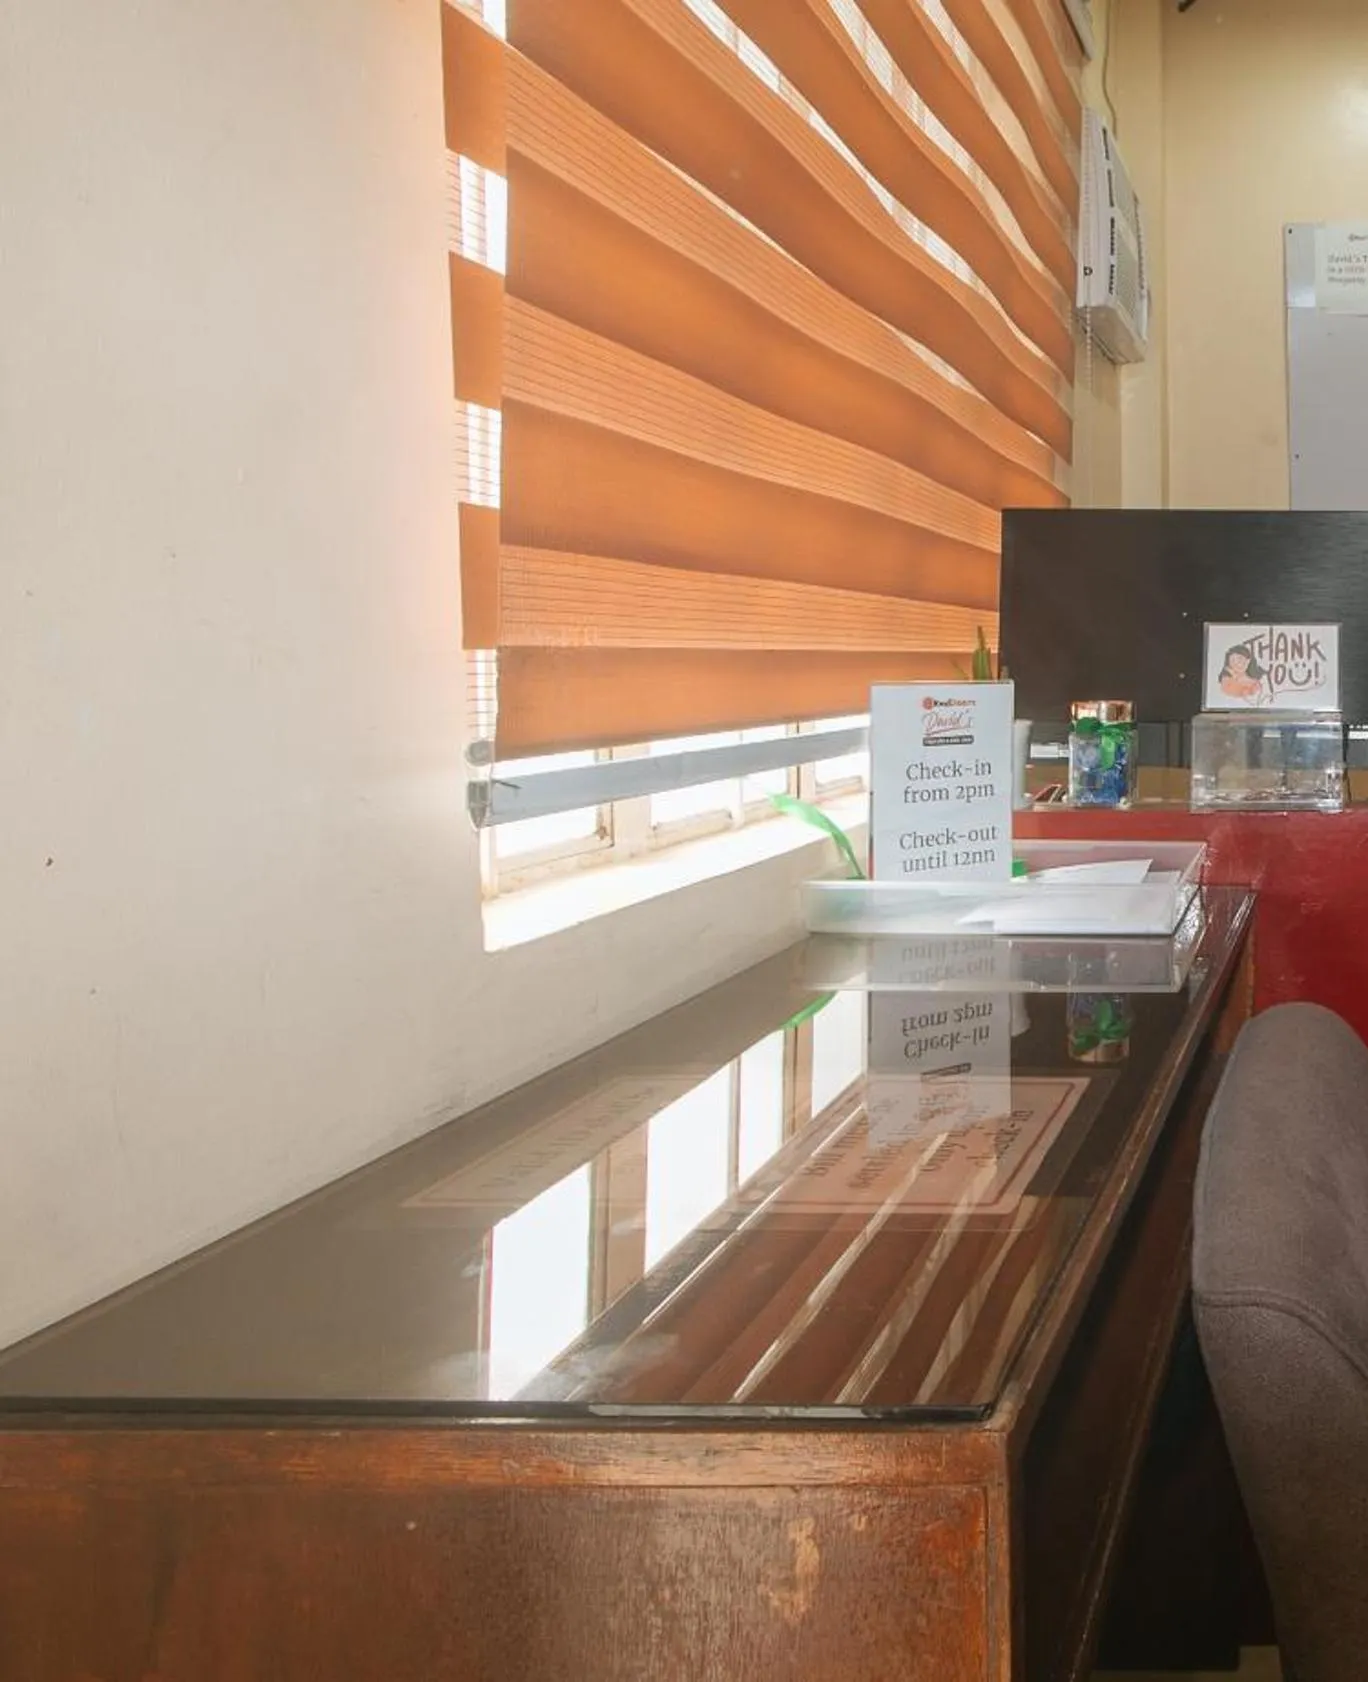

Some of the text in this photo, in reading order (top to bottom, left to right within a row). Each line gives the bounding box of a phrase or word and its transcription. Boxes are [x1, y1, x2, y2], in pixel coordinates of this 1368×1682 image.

[1243, 627, 1327, 662] THANK
[905, 759, 992, 781] Check-in
[903, 783, 995, 803] from 2pm
[899, 825, 998, 850] Check-out
[902, 849, 995, 873] until 12nn
